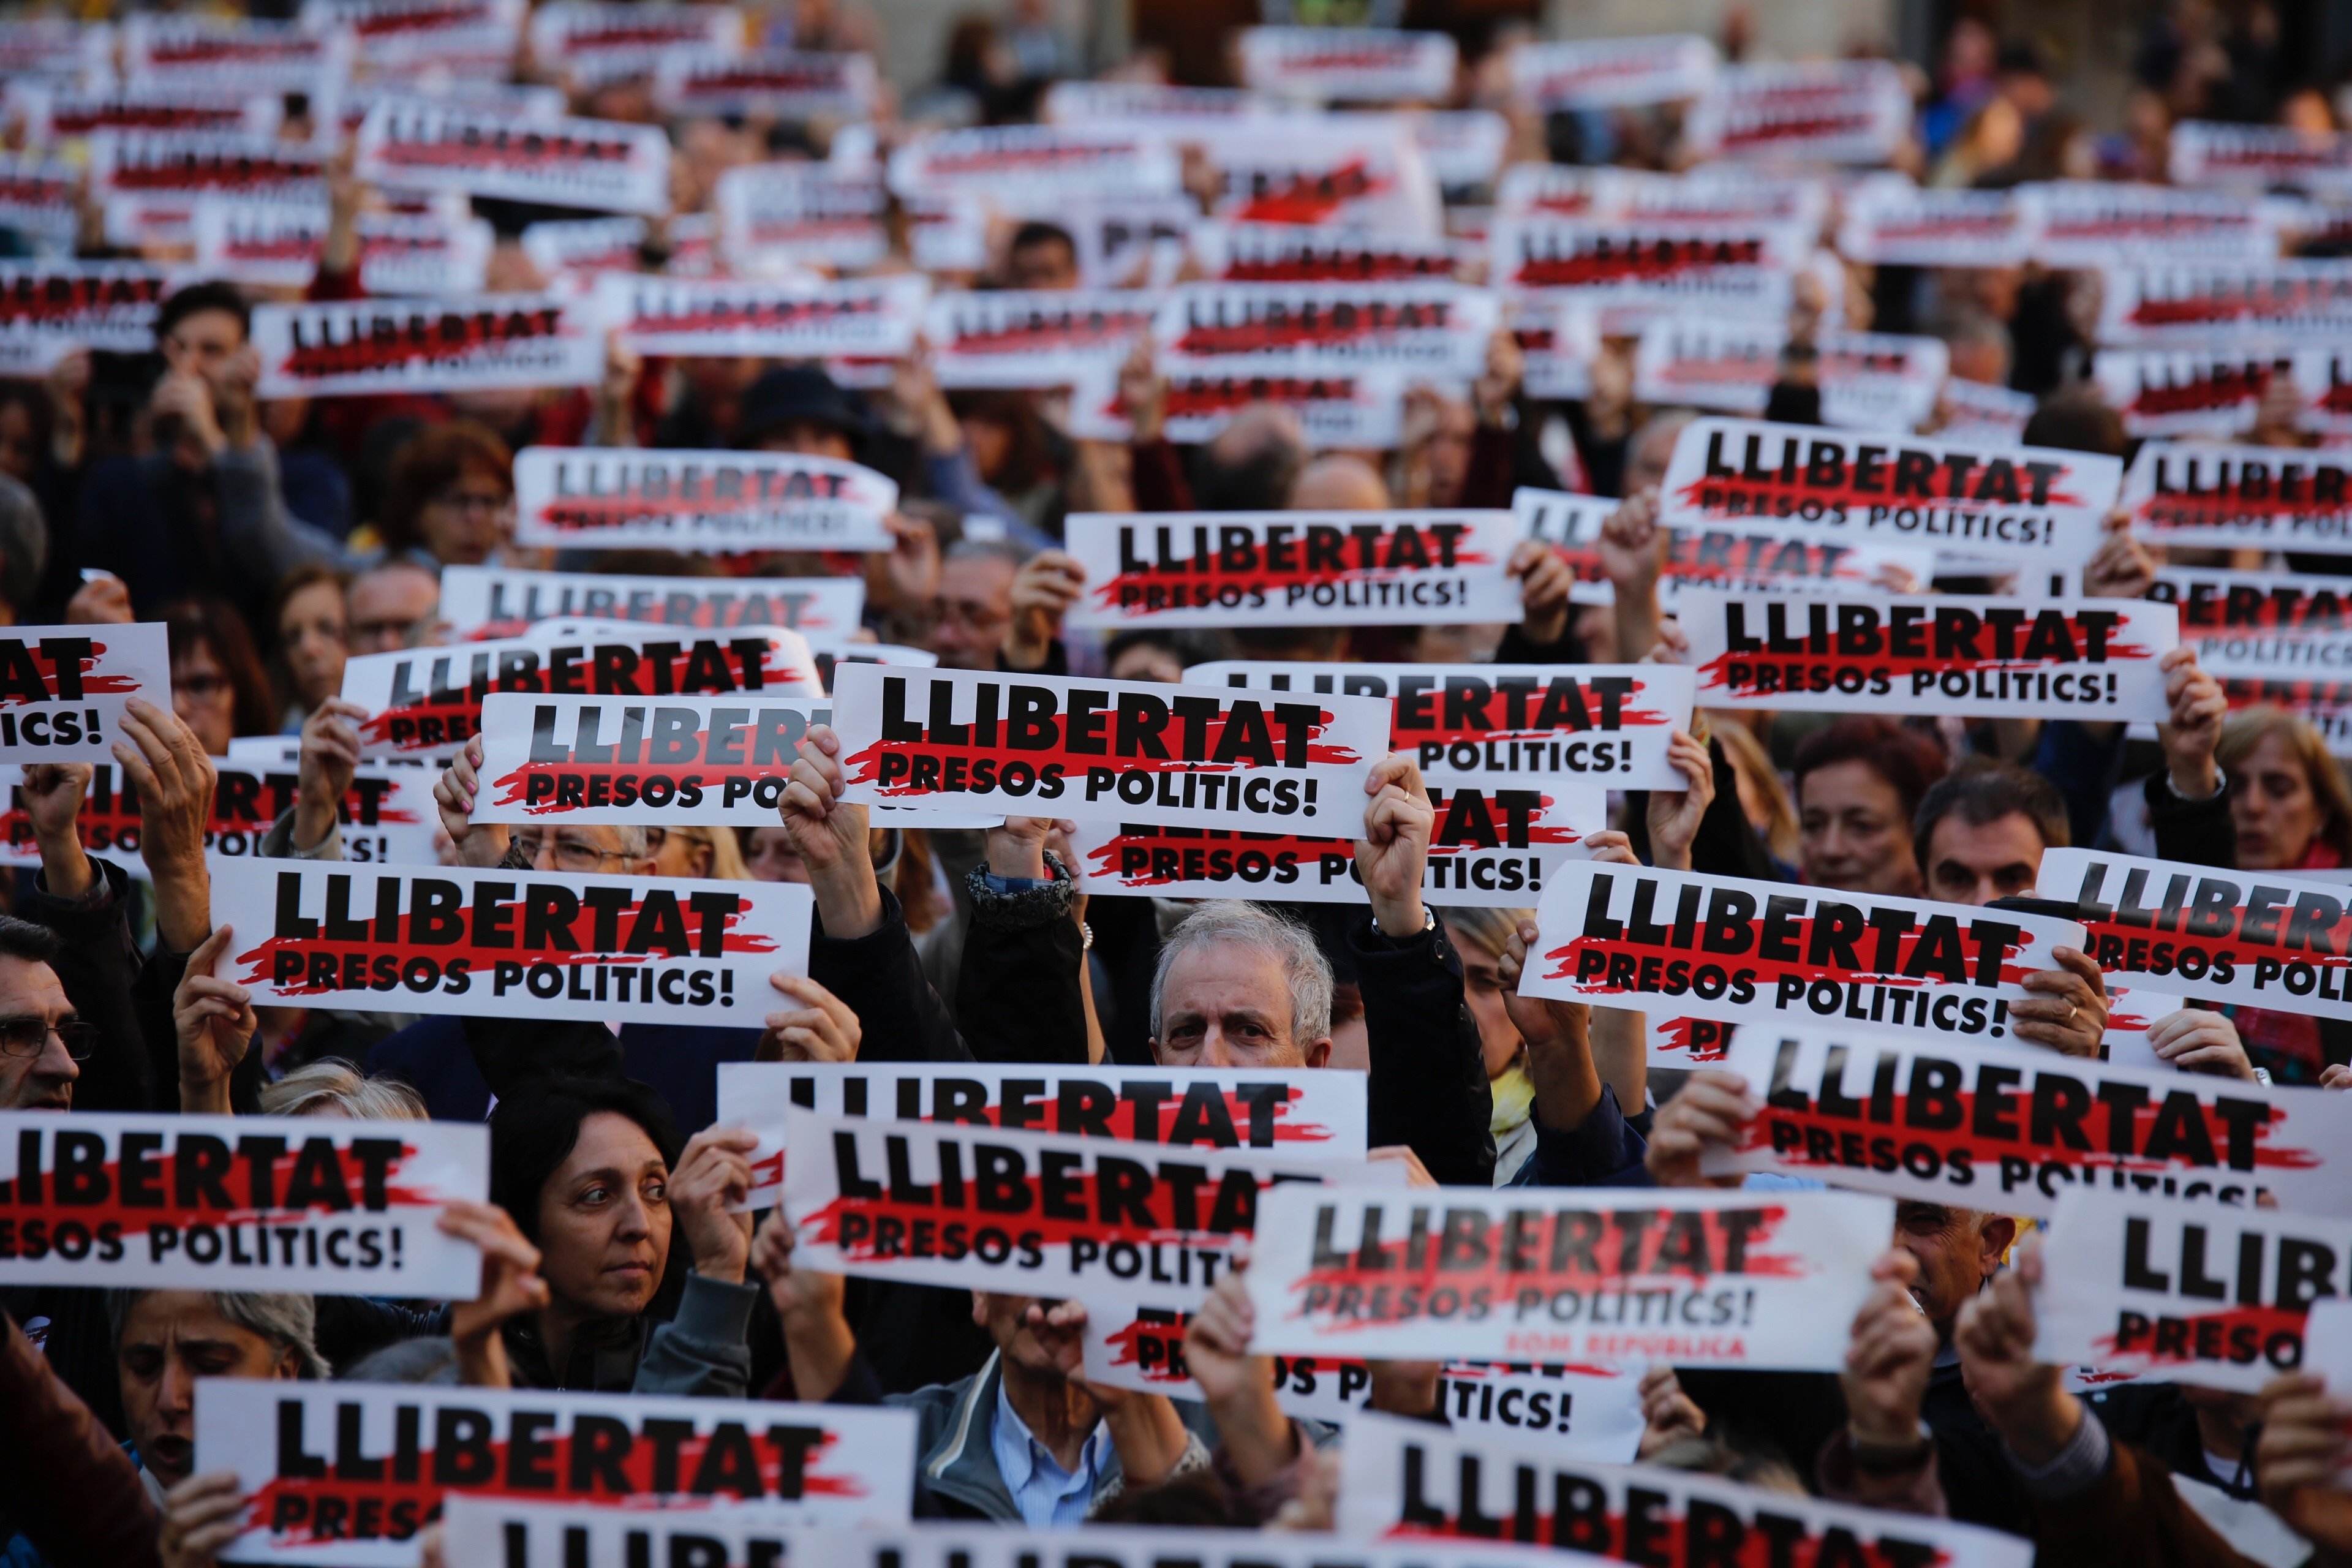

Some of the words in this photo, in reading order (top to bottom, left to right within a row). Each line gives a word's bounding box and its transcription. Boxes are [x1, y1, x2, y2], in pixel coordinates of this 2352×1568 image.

[557, 461, 851, 501] LLIBERTAT
[1706, 432, 2062, 507] LLIBERTAT
[2155, 457, 2352, 504] LLIBER
[1702, 488, 1848, 525] PRESOS
[1869, 503, 2054, 545] POLÍTICS!
[1120, 524, 1464, 573] LLIBERTAT
[1120, 581, 1267, 610] PRESOS
[1286, 577, 1467, 608] POLÍTICS!
[1725, 602, 2117, 663] LLIBERTAT
[390, 638, 769, 708] LLIBERTAT
[1728, 663, 1892, 695] PRESOS
[1912, 659, 2118, 704] POLÍTICS!
[529, 705, 832, 766] LLIBER
[882, 677, 1321, 769] LLIBERTAT
[1420, 733, 1631, 772] POLÍTICS!
[526, 773, 704, 809] PRESOS
[878, 753, 1065, 799] PRESOS
[1085, 762, 1317, 817] POLÍTICS!
[1121, 844, 1300, 885] PRESOS
[274, 872, 739, 959] LLIBERTAT
[1582, 873, 2021, 989] LLIBERTAT
[2078, 862, 2352, 959] LLIBER
[273, 951, 471, 994] PRESOS
[492, 954, 734, 1007] POLÍTICS!
[1576, 948, 1757, 1005] PRESOS
[1776, 975, 2009, 1039] POLÍTICS!
[1766, 1039, 2272, 1172] LLIBERTAT
[834, 1131, 1322, 1233] LLIBERTA
[1769, 1118, 1975, 1188] PRESOS
[148, 1213, 404, 1270] POLÍTICS!
[839, 1212, 1044, 1269] PRESOS
[1313, 1204, 1763, 1275] LLIBERTAT
[2124, 1217, 2352, 1312] LLIB
[1303, 1282, 1492, 1328] PRESOS
[1515, 1280, 1756, 1327] POLÍTICS!
[2117, 1310, 2304, 1371] PRESO
[276, 1400, 823, 1501] LLIBERTAT
